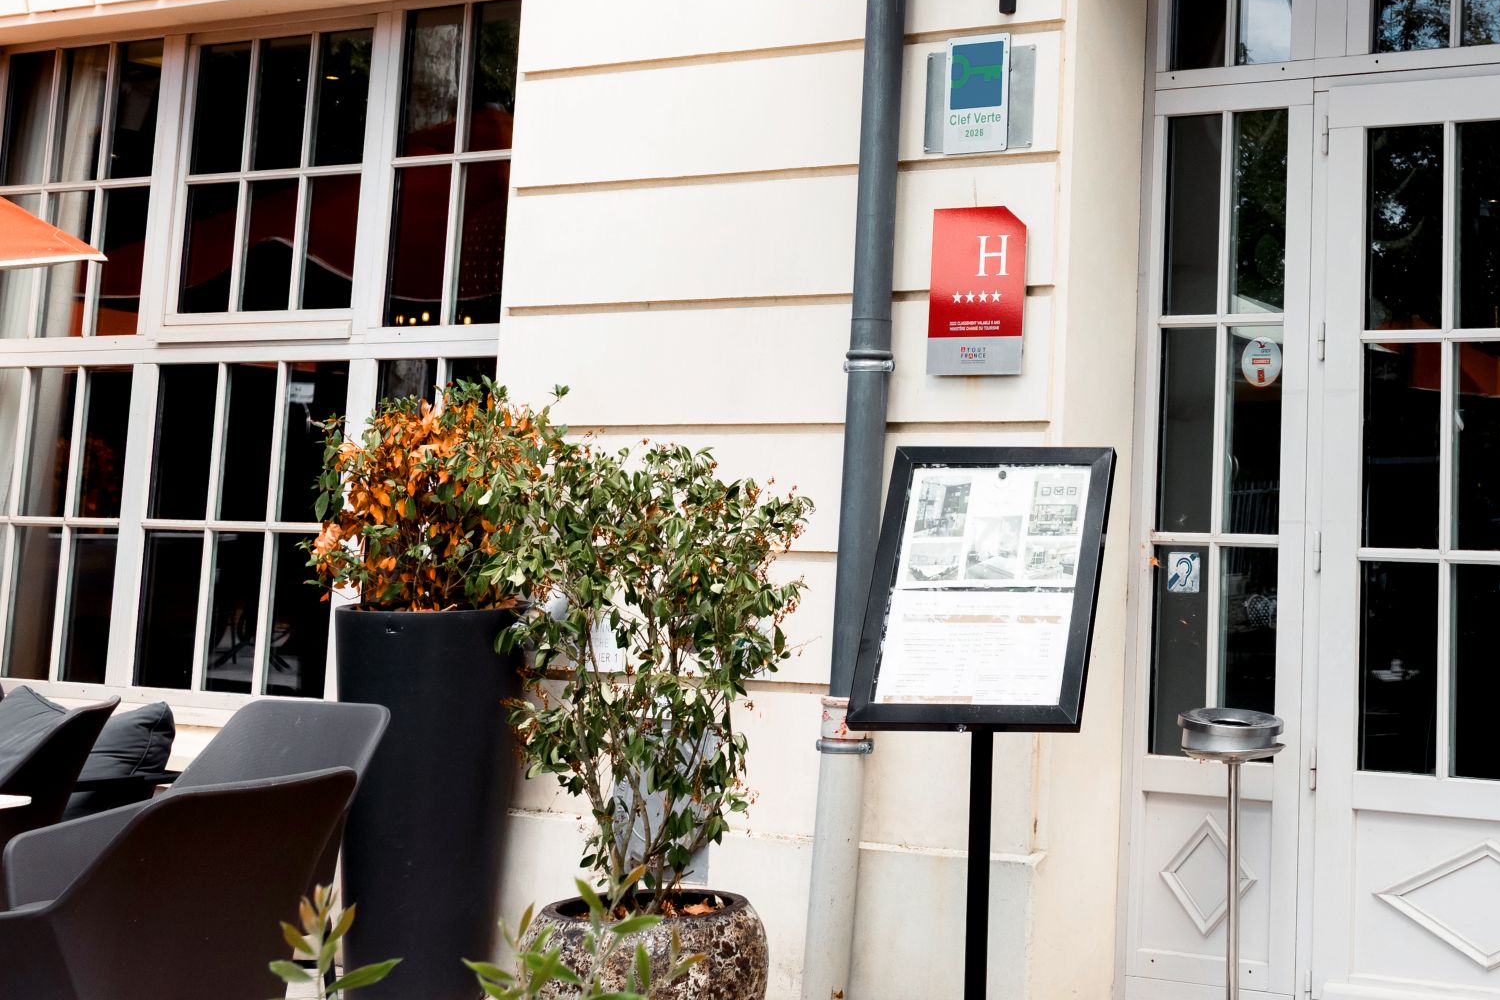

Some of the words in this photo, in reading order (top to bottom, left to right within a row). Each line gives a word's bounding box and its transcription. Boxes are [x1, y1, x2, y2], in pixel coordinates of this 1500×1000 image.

[949, 112, 971, 126] Clef
[973, 111, 1001, 124] Verte
[975, 234, 1012, 277] H
